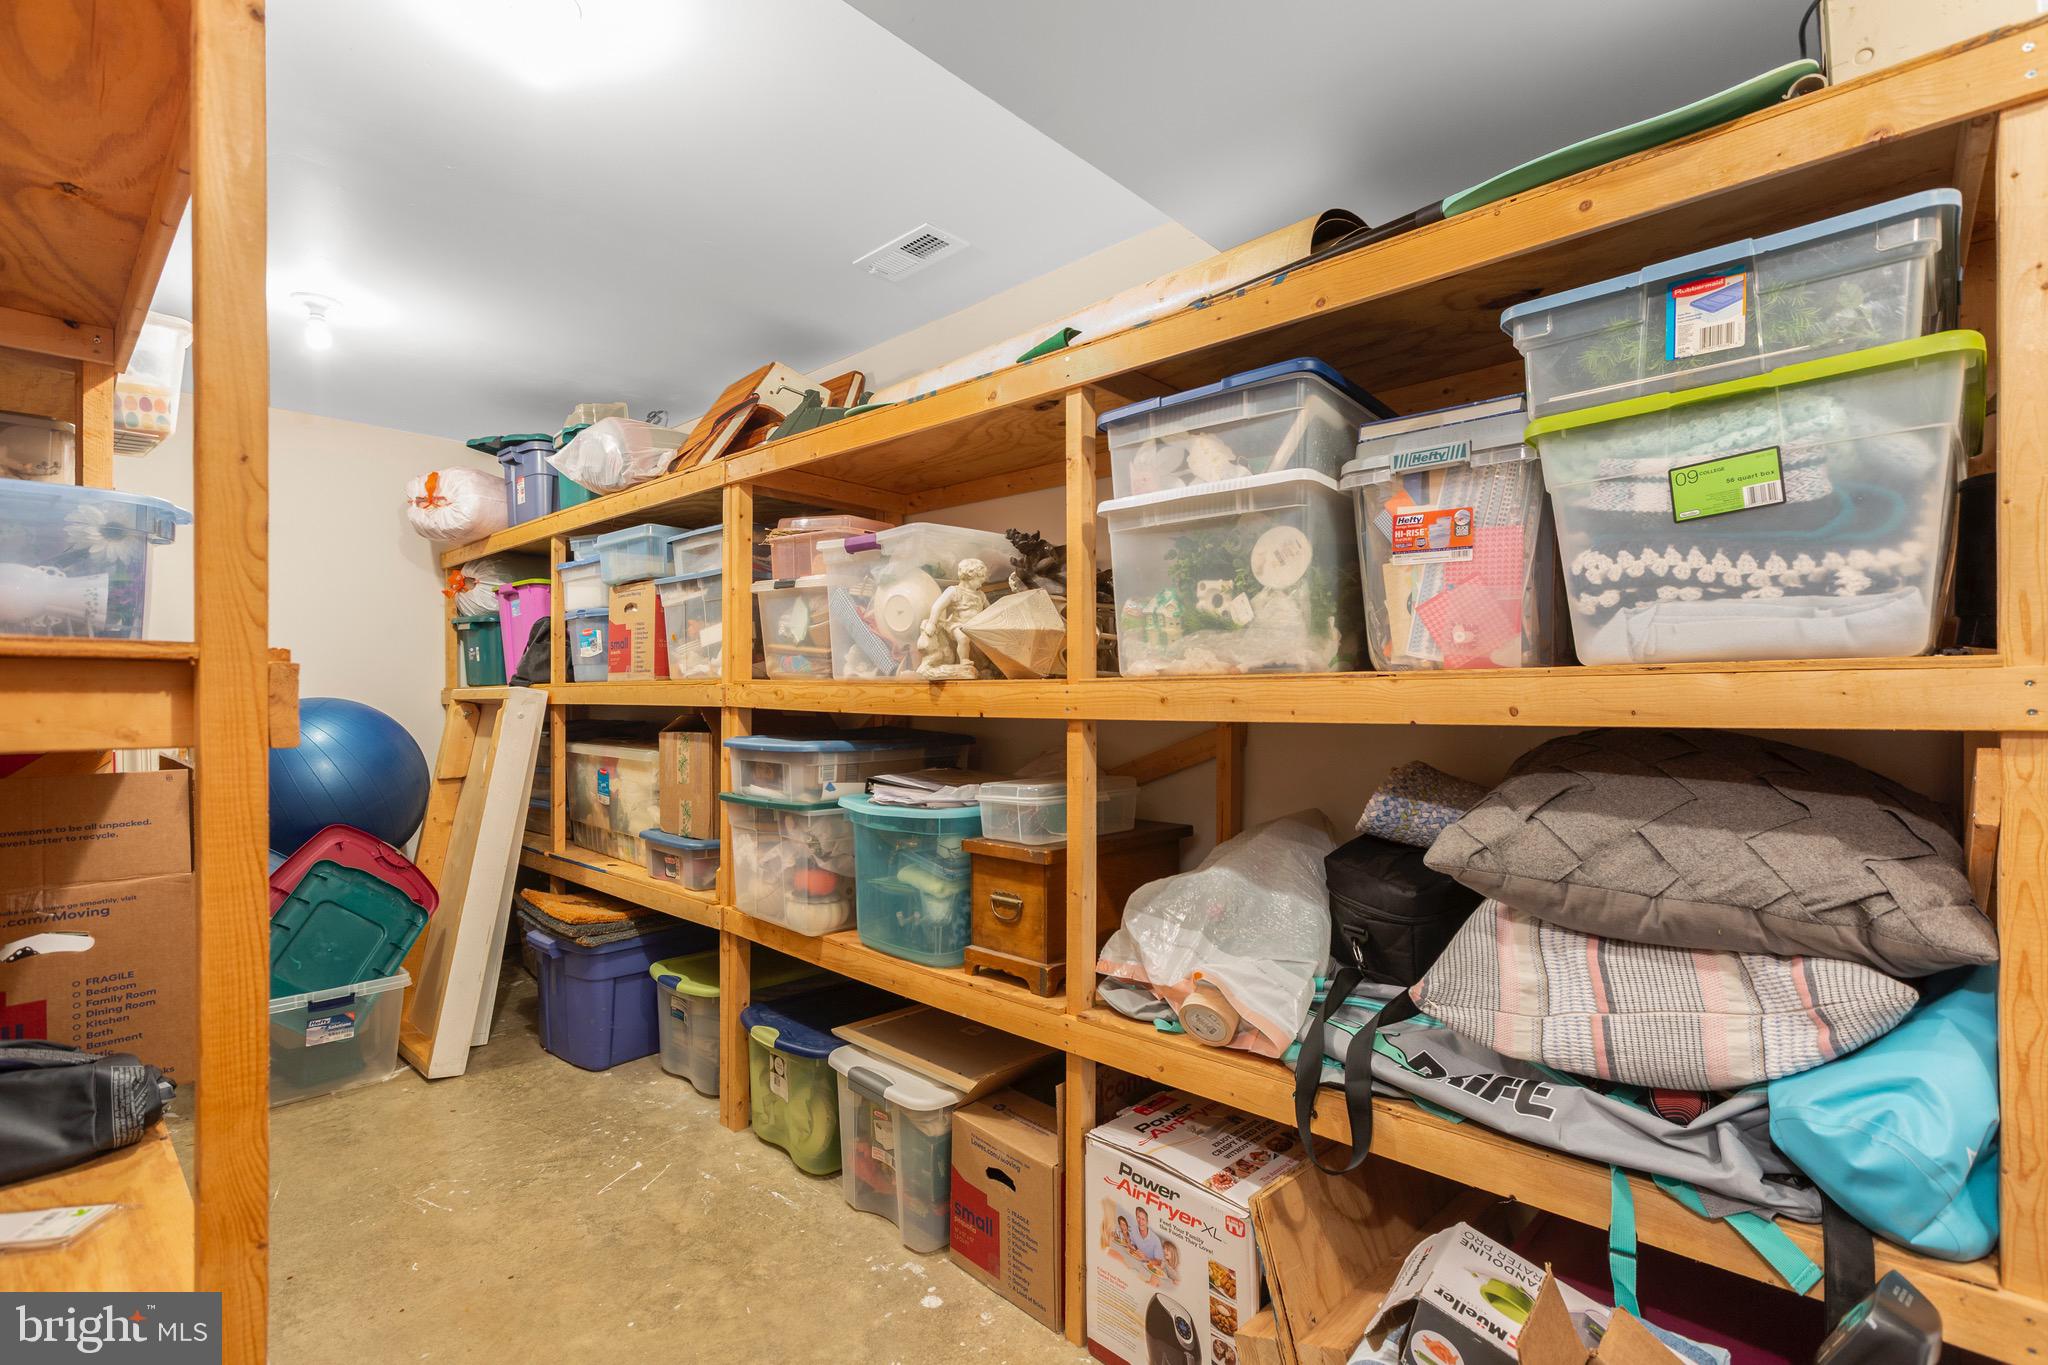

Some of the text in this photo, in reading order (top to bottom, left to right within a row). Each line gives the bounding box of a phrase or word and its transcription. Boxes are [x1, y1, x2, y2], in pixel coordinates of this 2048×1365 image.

[1674, 279, 1724, 295] Rubbermaid
[1412, 451, 1447, 464] Hefty
[1675, 466, 1725, 487] 09 COLLEGE
[1737, 473, 1759, 482] quart
[1397, 515, 1423, 525] Hefty
[1394, 528, 1425, 538] HI-RISE
[610, 637, 629, 650] small
[0, 827, 52, 838] awesome
[84, 823, 97, 831] all
[99, 818, 152, 830] unpacked.
[0, 841, 26, 849] even
[29, 837, 62, 846] better
[79, 831, 119, 842] recycle.
[0, 910, 18, 918] ake
[43, 904, 65, 912] move
[67, 903, 78, 911] go
[80, 897, 119, 909] smoothly,
[121, 894, 137, 902] visit
[0, 906, 111, 929] .com/Moving
[86, 970, 135, 986] FRAGILE
[86, 981, 137, 997] Bedroom
[86, 988, 157, 1008] Family Room
[86, 998, 156, 1019] Dining Room
[86, 1014, 130, 1029] Kitchen
[310, 1019, 330, 1027] Hefty
[86, 1028, 113, 1040] Bath
[86, 1032, 143, 1050] Basement
[1134, 1103, 1192, 1134] Power
[1150, 1101, 1219, 1139] AirFrye
[1212, 1134, 1232, 1148] ENJOY
[1212, 1140, 1238, 1157] CRISPY
[1118, 1161, 1181, 1200] Power
[954, 1201, 993, 1238] small
[1116, 1178, 1222, 1243] AirFryer XL
[1185, 1230, 1205, 1245] Family
[1464, 1230, 1543, 1282] RATER PRO
[1433, 1287, 1508, 1342] Müeller
